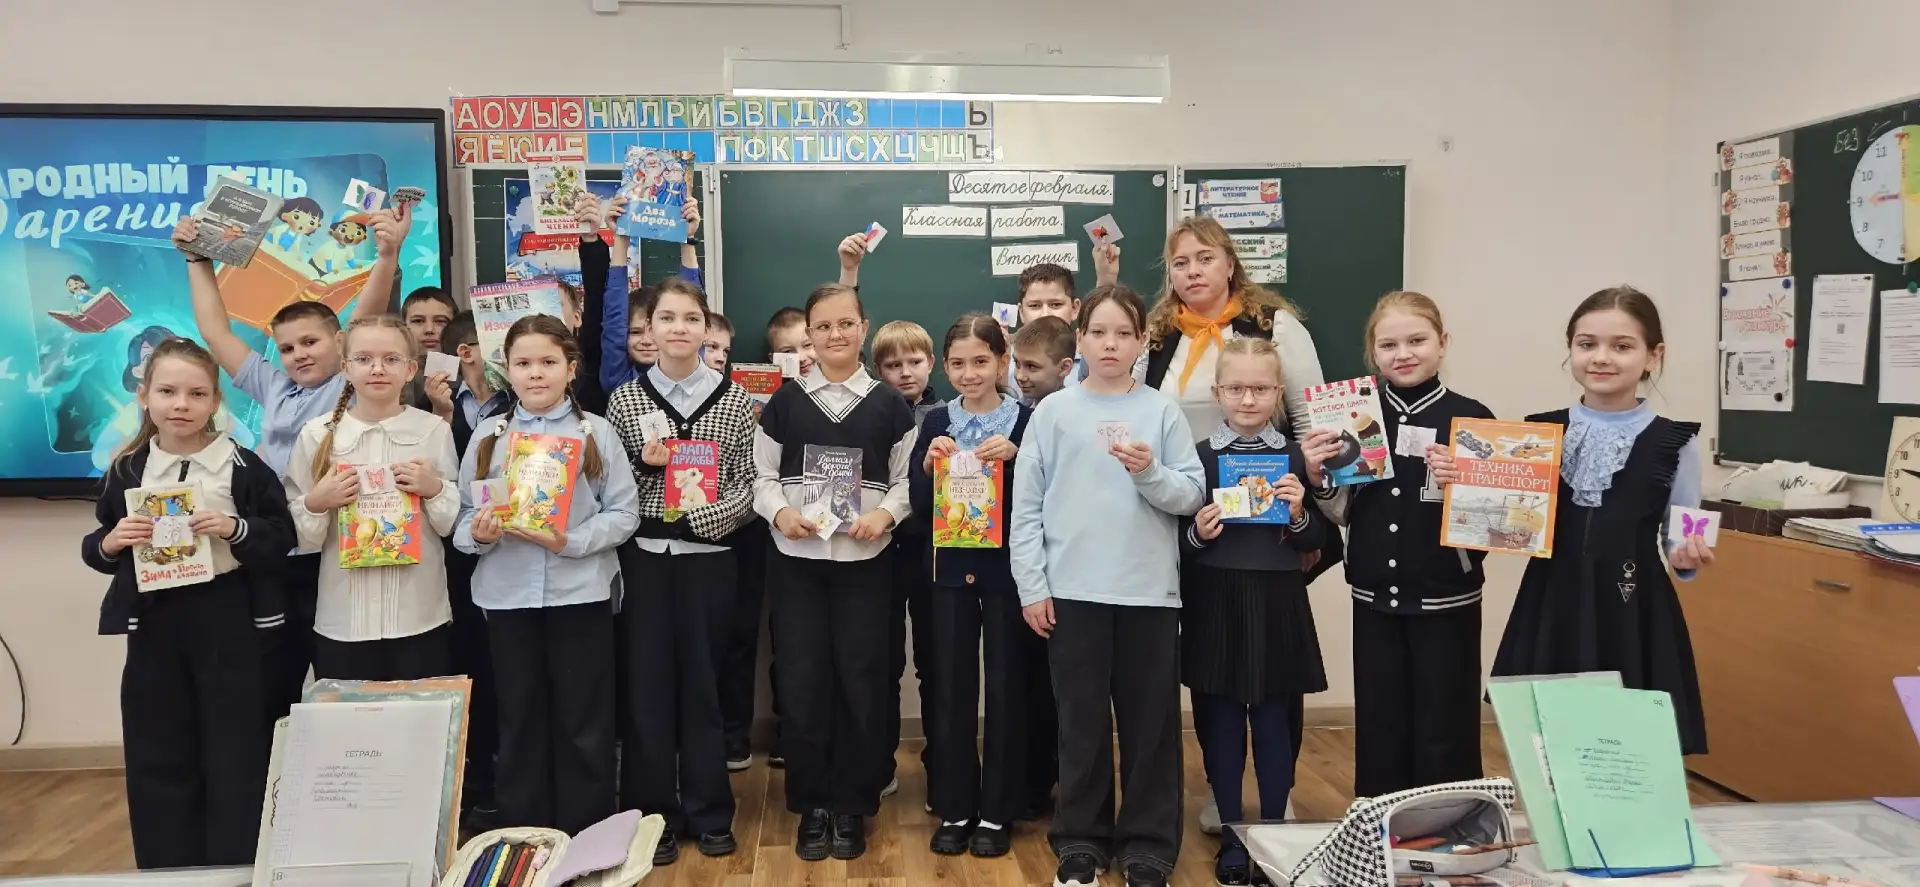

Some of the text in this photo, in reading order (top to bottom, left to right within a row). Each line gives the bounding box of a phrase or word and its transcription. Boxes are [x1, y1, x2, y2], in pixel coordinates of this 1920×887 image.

[0, 157, 189, 200] РОДНЫЙ
[950, 173, 1114, 202] Десятое февраля.
[642, 205, 666, 216] Два
[903, 207, 1064, 230] Классная работа.
[1218, 210, 1266, 218] МАТЕМАТИКА
[0, 201, 207, 249] арени
[1233, 236, 1265, 246] ССКИЙ
[996, 247, 1078, 266] Вторник.
[680, 442, 715, 456] ЛАПА
[671, 454, 715, 466] ДРУЖБЫ
[1470, 460, 1535, 476] ТЕХНИКА
[1469, 472, 1550, 490] ТРАНСПОРТ
[345, 750, 382, 758] ТЕТРАДЬ
